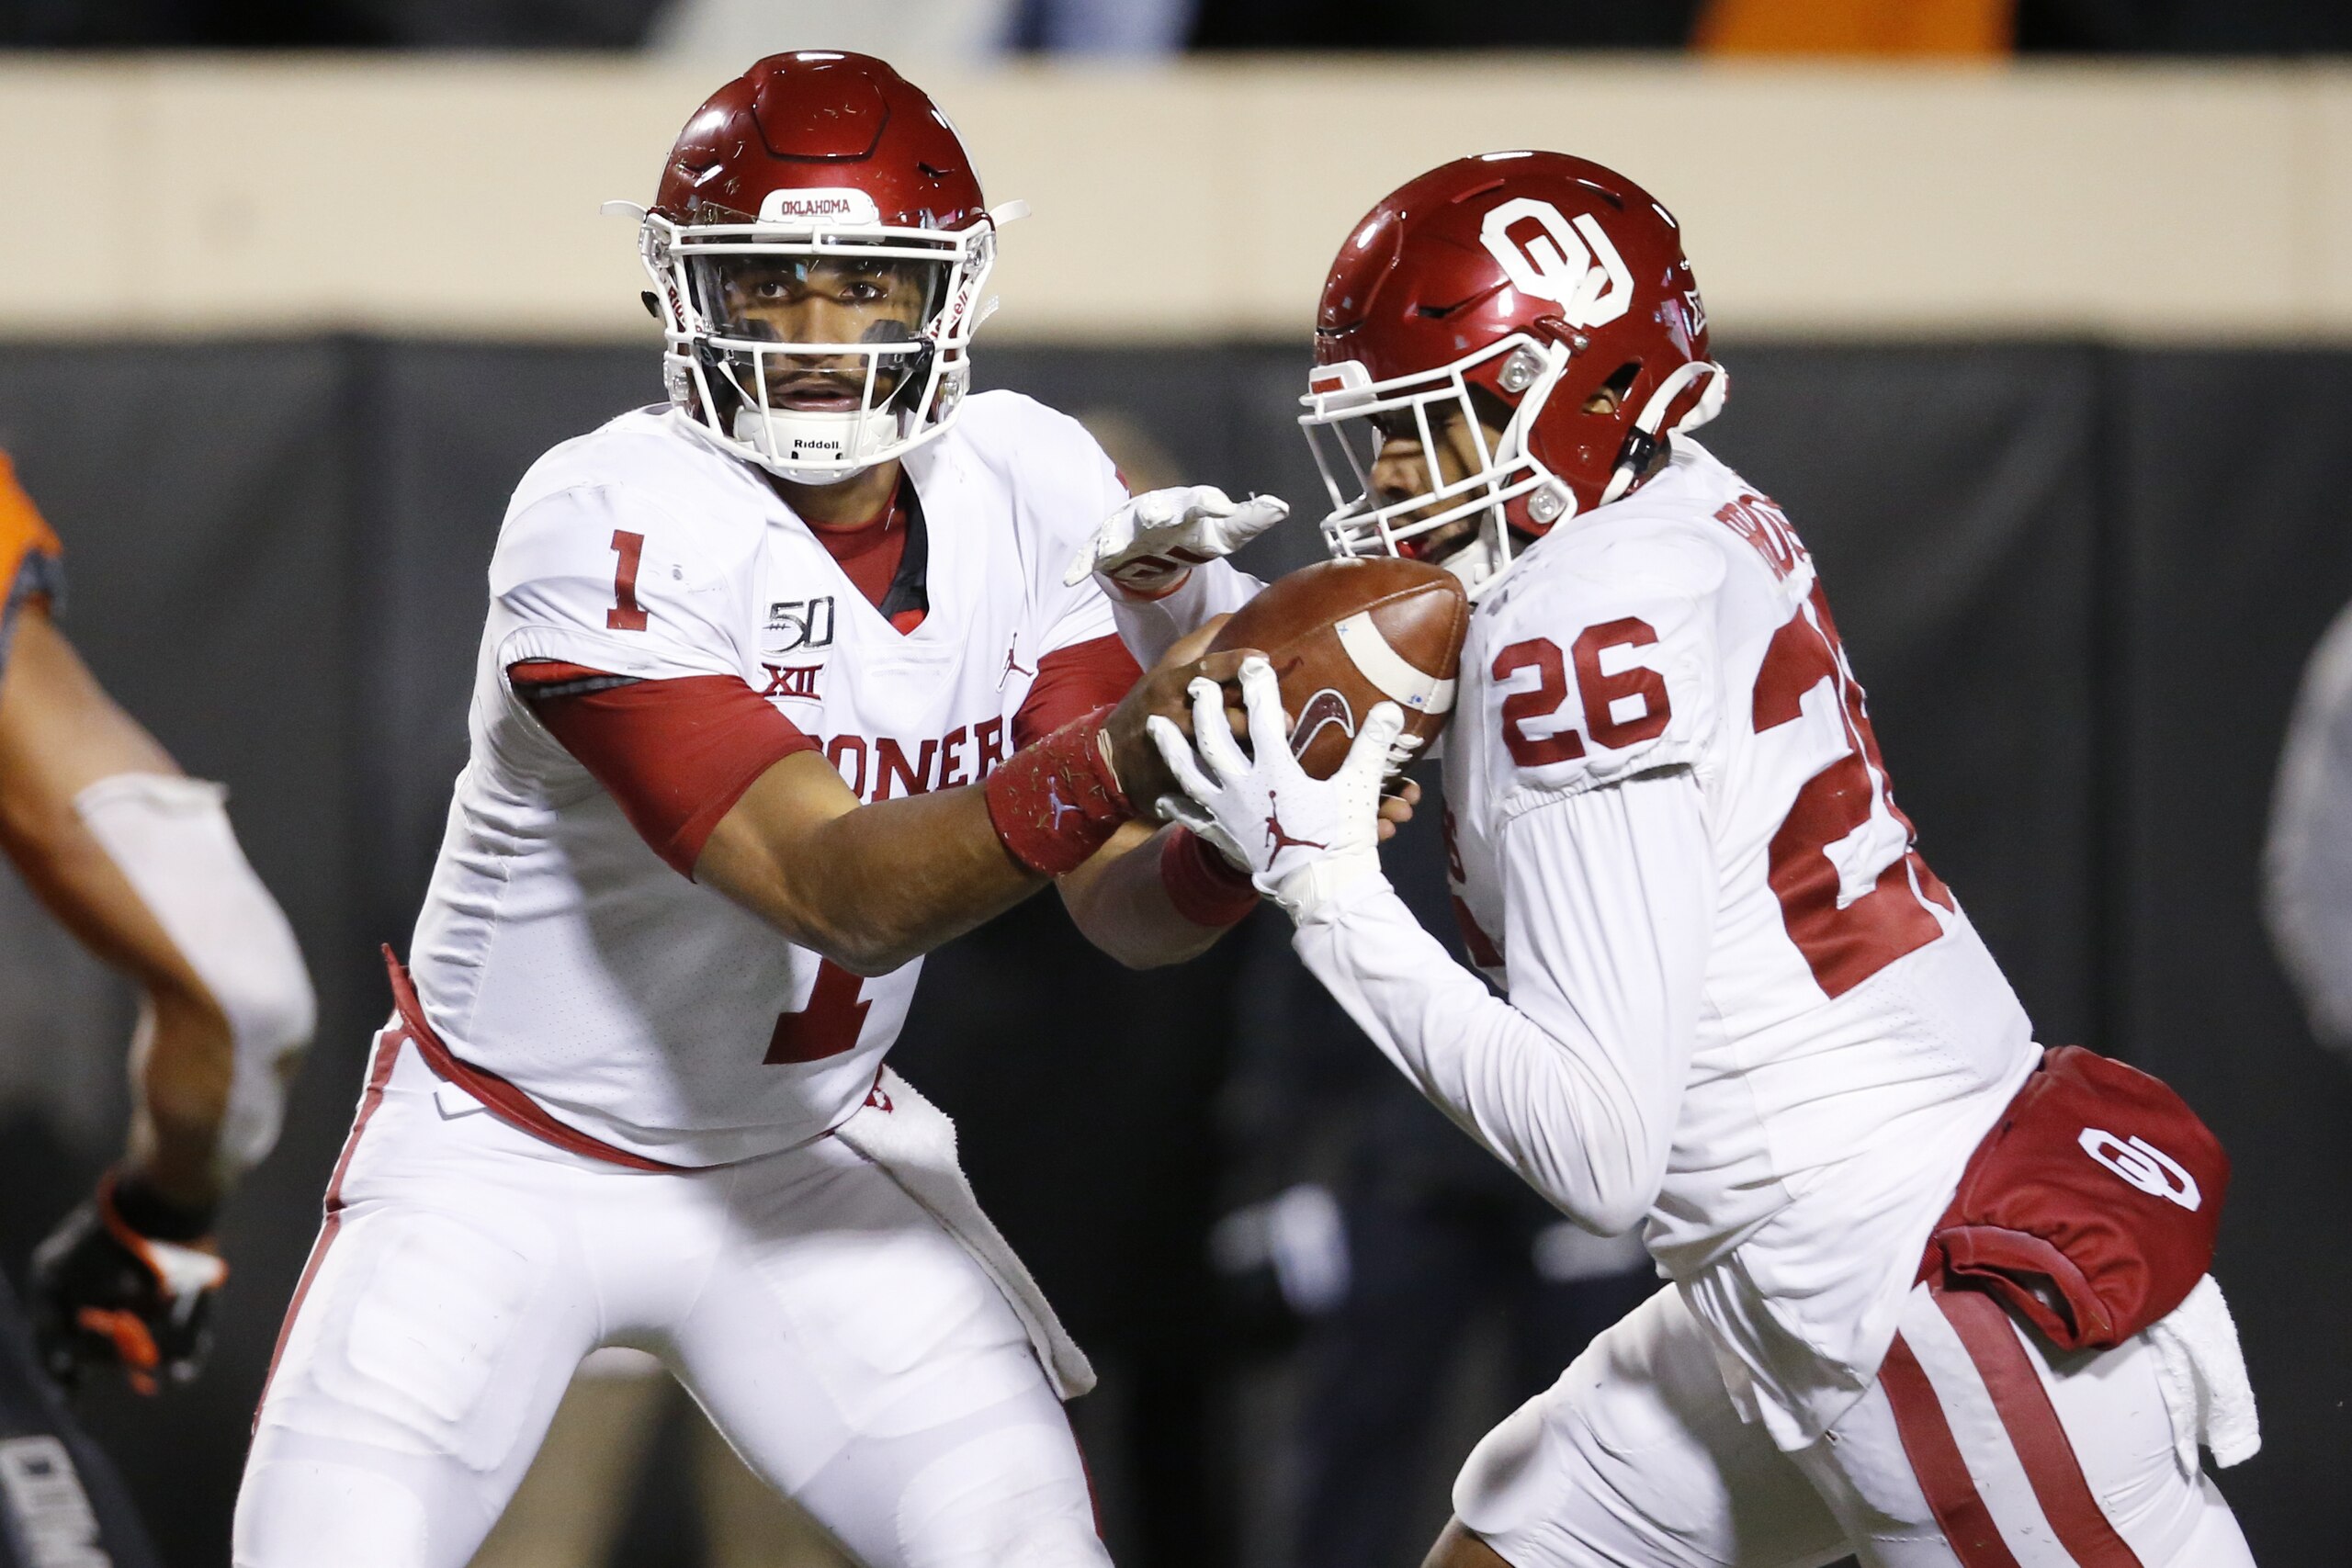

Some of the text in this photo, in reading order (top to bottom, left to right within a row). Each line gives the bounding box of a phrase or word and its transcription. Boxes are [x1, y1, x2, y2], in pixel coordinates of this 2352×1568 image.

[781, 198, 851, 216] OKLAHOMA
[1478, 197, 1635, 329] OU
[793, 438, 840, 449] Riddell
[606, 529, 647, 631] 1
[761, 596, 834, 654] 50
[761, 661, 824, 701] XII
[1492, 616, 1671, 766] 26
[2076, 1126, 2202, 1213] OU
